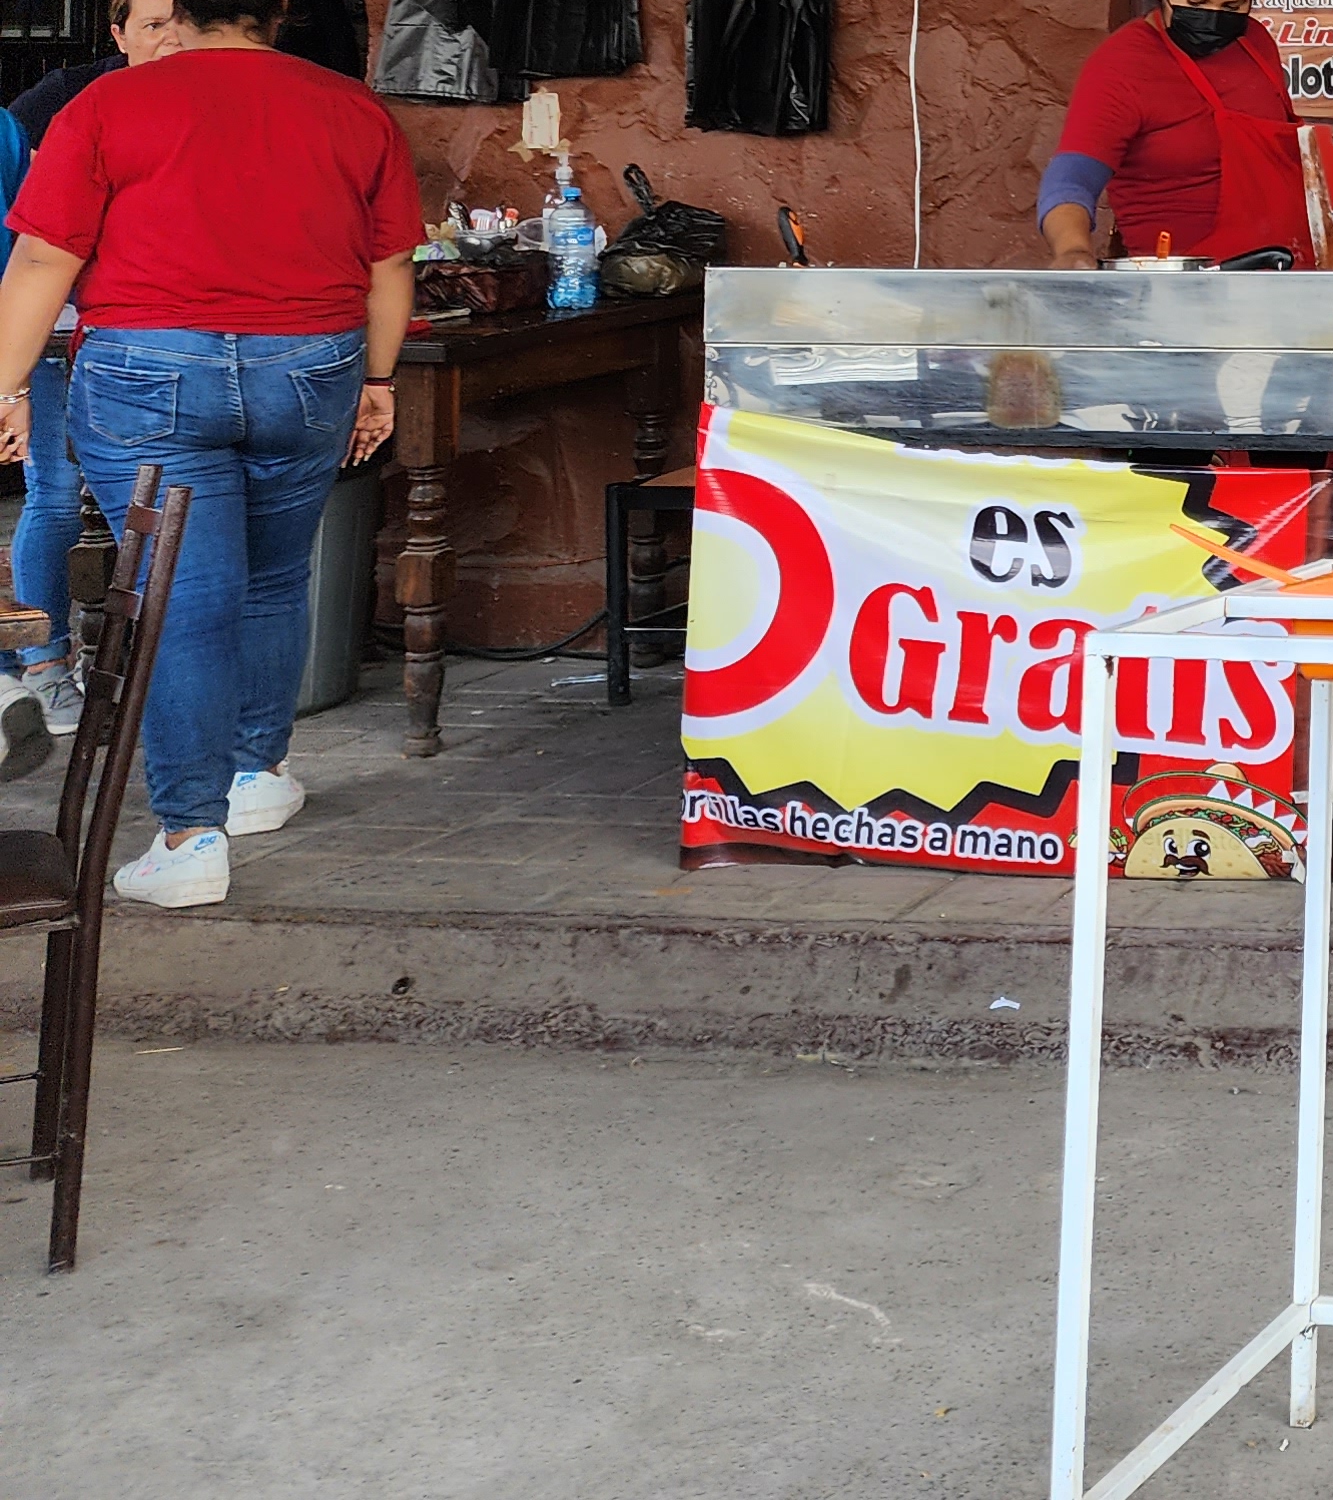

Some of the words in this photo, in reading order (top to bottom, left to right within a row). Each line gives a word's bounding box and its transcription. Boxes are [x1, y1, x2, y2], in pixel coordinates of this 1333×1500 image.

[968, 505, 1076, 589] es
[789, 805, 917, 850] hechas
[928, 825, 950, 854] a
[961, 830, 1059, 862] mano
